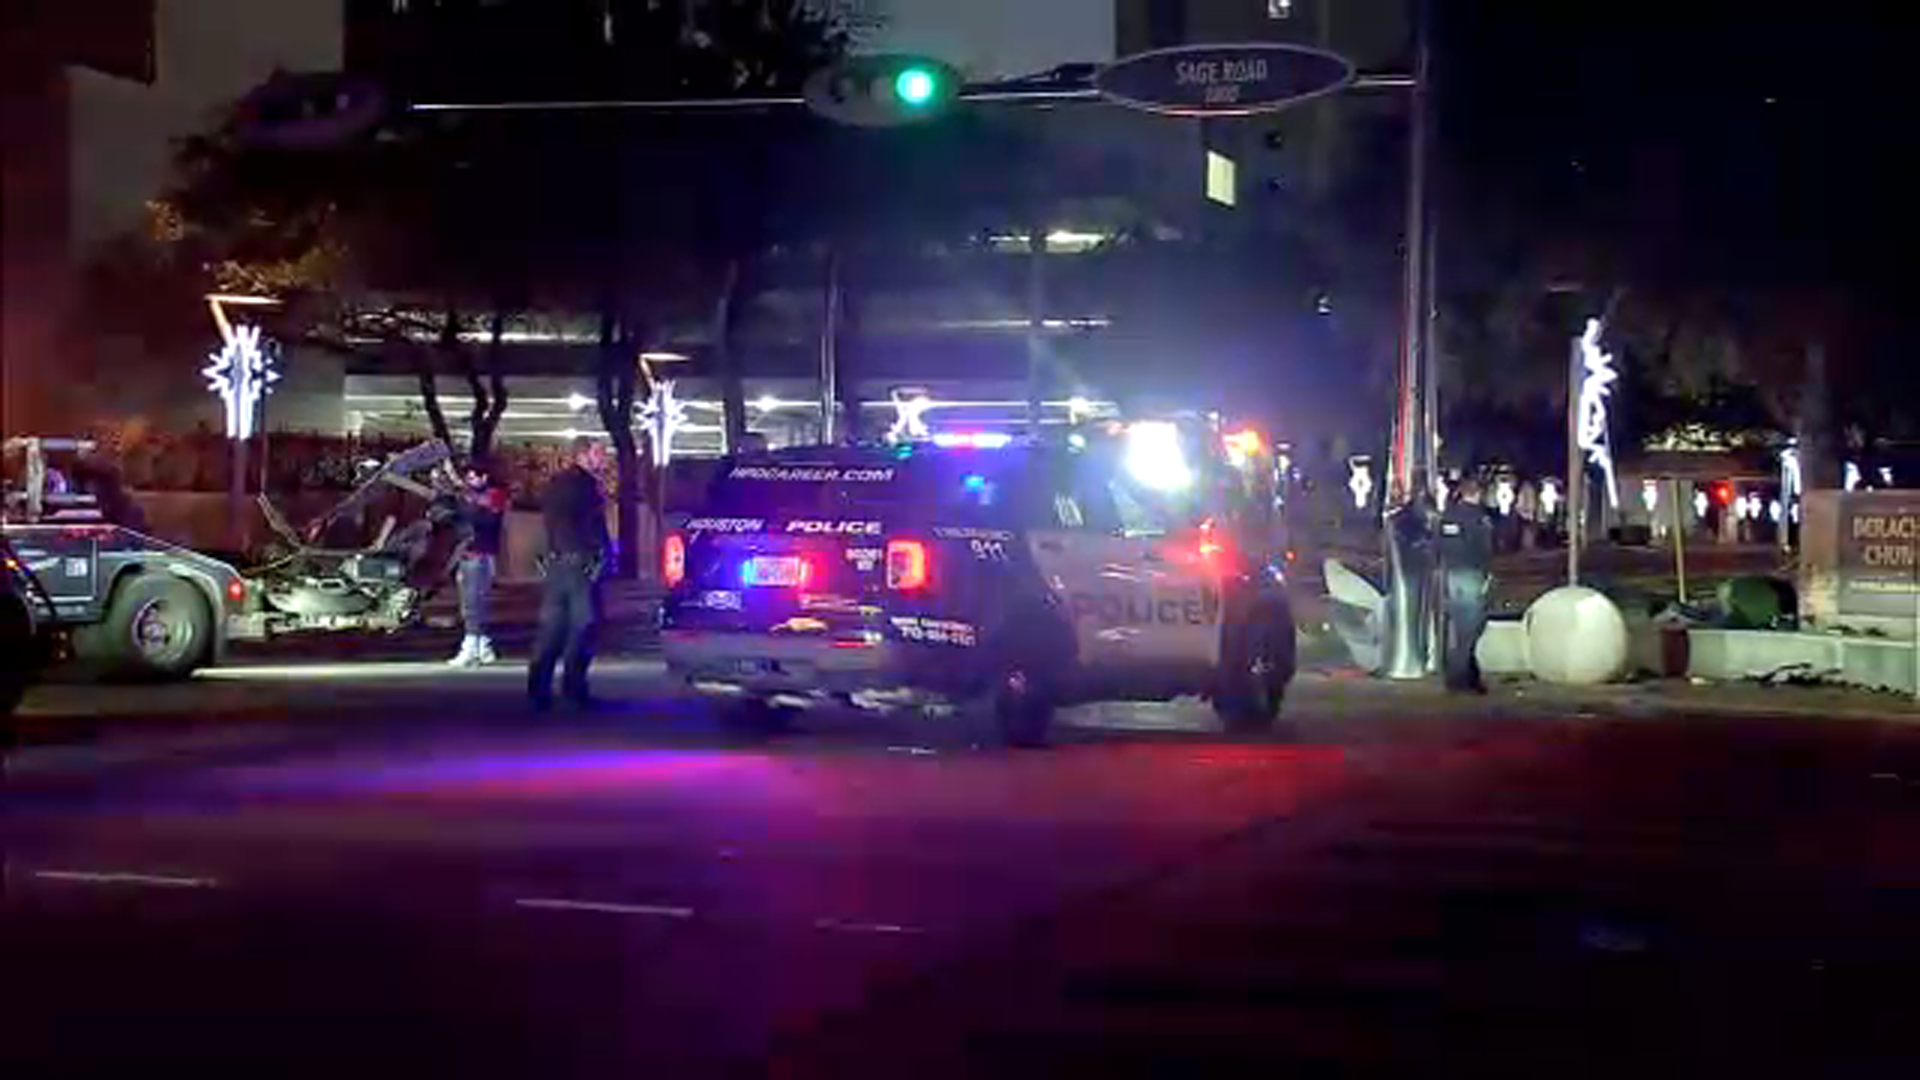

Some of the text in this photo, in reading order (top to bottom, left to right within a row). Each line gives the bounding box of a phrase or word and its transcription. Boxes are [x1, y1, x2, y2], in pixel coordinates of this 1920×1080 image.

[1175, 58, 1268, 85] SAGE ROAD
[687, 517, 882, 535] HOUSTON POLICE
[1072, 592, 1203, 626] POLICE
